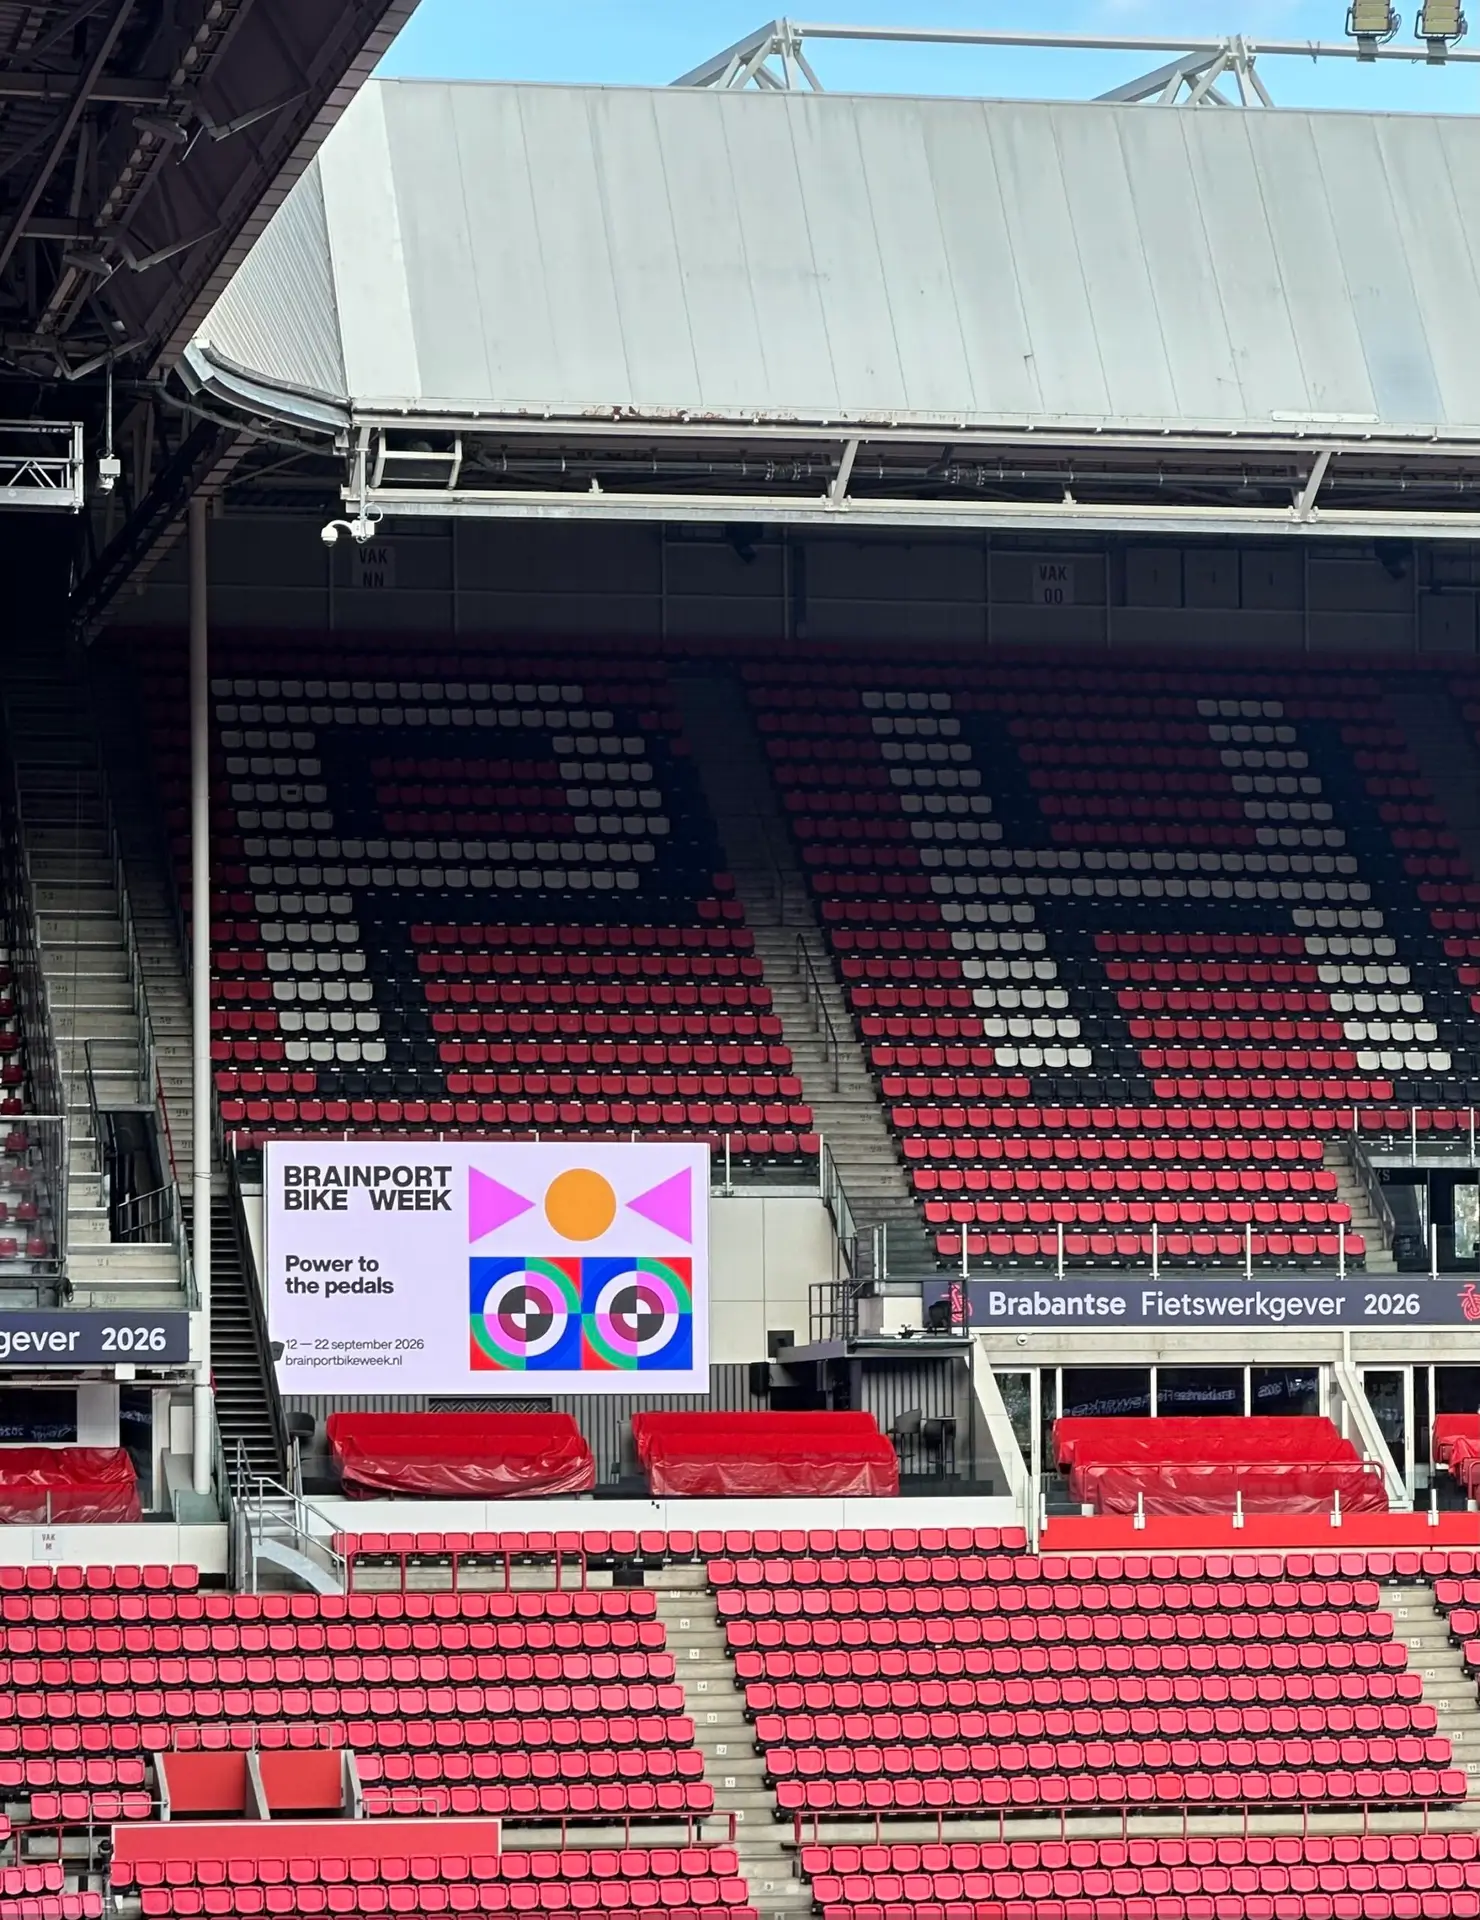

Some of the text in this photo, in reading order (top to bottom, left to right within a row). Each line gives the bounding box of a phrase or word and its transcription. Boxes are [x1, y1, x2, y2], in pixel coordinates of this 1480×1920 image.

[359, 547, 388, 565] VAK
[363, 571, 384, 587] NN
[1039, 565, 1067, 581] VAK
[284, 1165, 453, 1187] BRAINPORT
[284, 1190, 453, 1211] BIKE WEEK
[285, 1254, 380, 1273] Power to
[285, 1276, 395, 1299] the pedals
[989, 1291, 1421, 1322] Brabantse Fietswerkgever 2026
[101, 1327, 167, 1351] 2026
[285, 1338, 298, 1350] 12
[314, 1338, 330, 1350] 22
[331, 1338, 393, 1353] september
[395, 1338, 425, 1350] 2026
[285, 1354, 403, 1368] brainportbikeweek.nl
